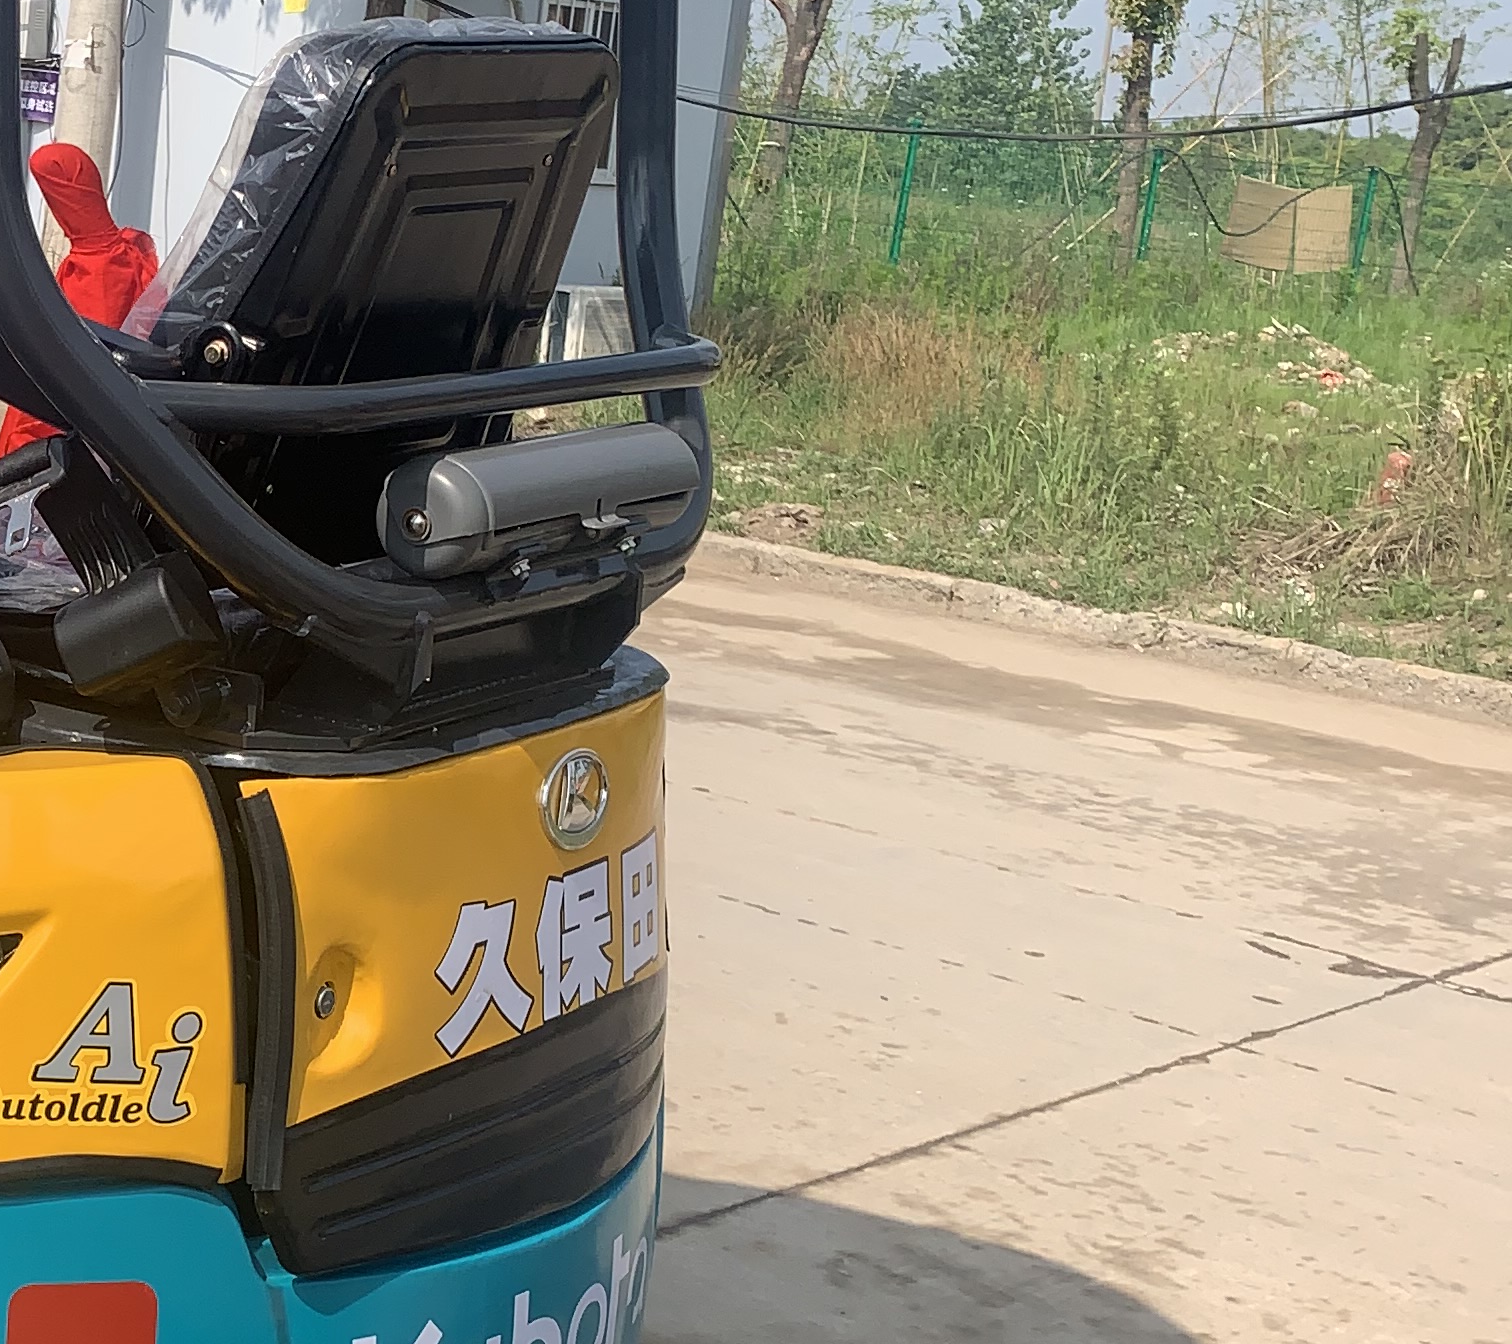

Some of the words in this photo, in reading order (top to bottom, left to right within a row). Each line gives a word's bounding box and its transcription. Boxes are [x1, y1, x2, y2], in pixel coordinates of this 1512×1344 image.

[434, 826, 660, 1058] 久保田
[31, 981, 203, 1124] Ai
